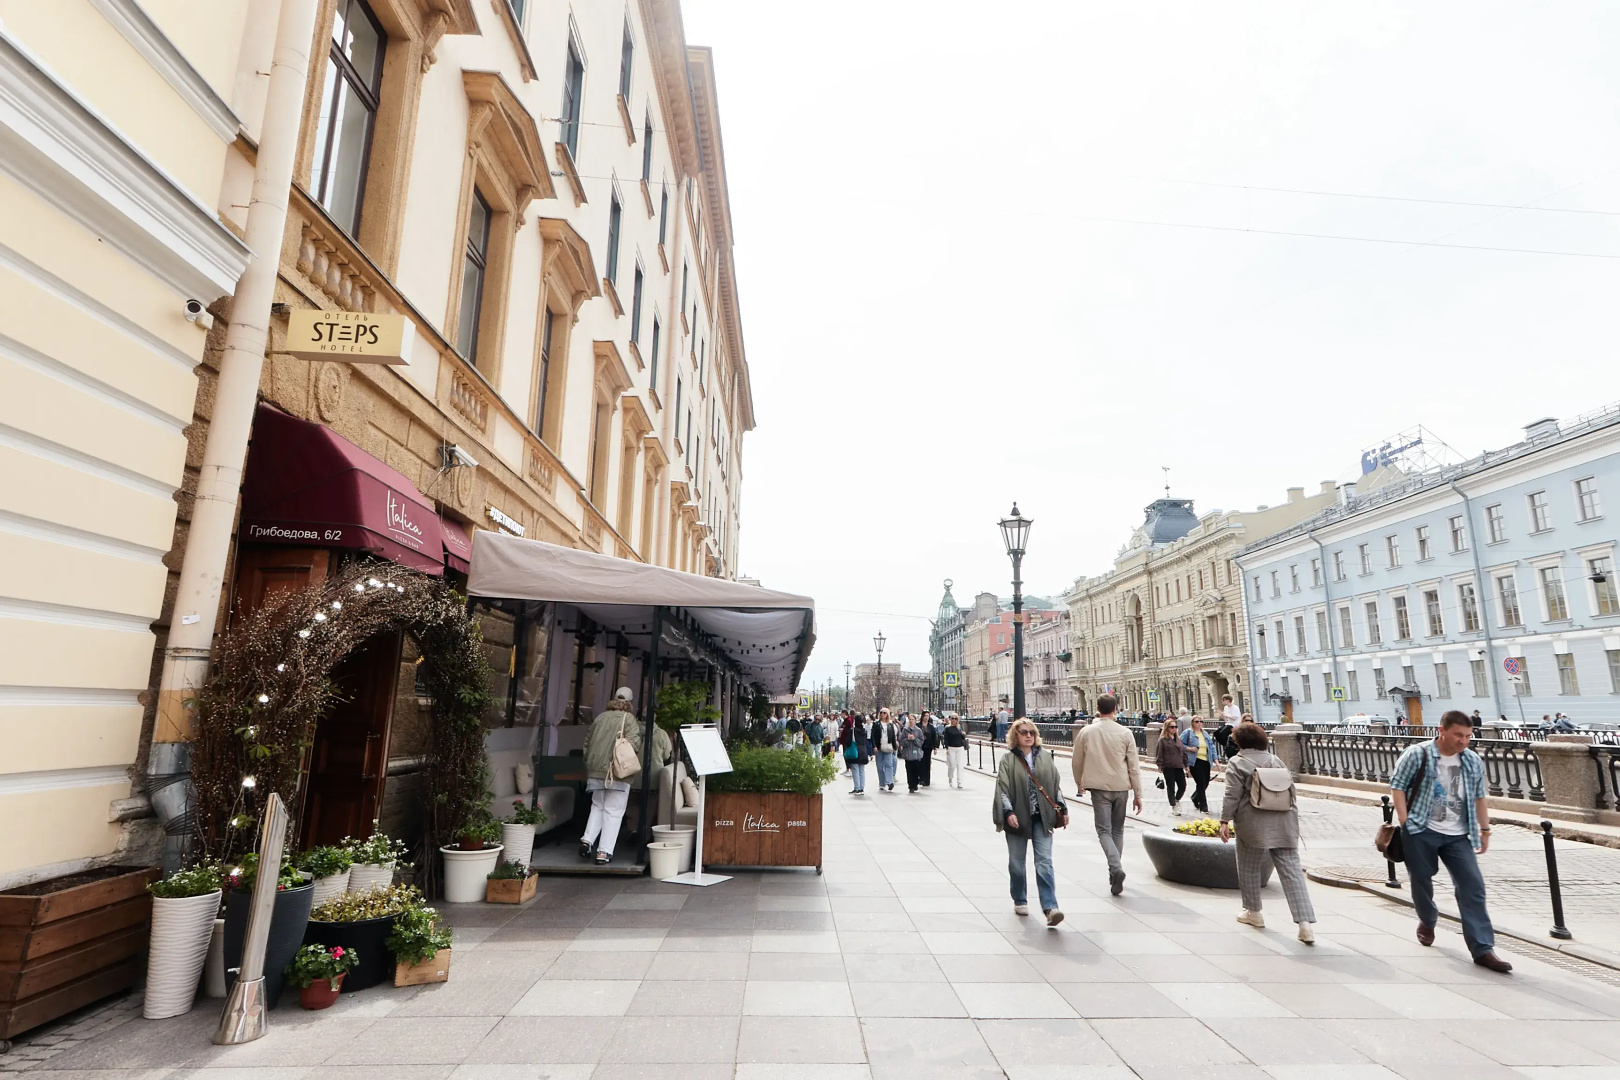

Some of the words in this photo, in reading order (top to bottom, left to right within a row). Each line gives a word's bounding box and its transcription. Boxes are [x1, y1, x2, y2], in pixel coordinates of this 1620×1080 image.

[325, 313, 368, 321] ОТЕЛЬ
[311, 322, 379, 344] STEPS
[386, 490, 422, 535] Italica
[249, 525, 320, 540] Грибоедова,
[324, 530, 342, 540] 6/2
[715, 819, 734, 827] pizza
[742, 812, 780, 832] Italica
[787, 819, 807, 827] pasta
